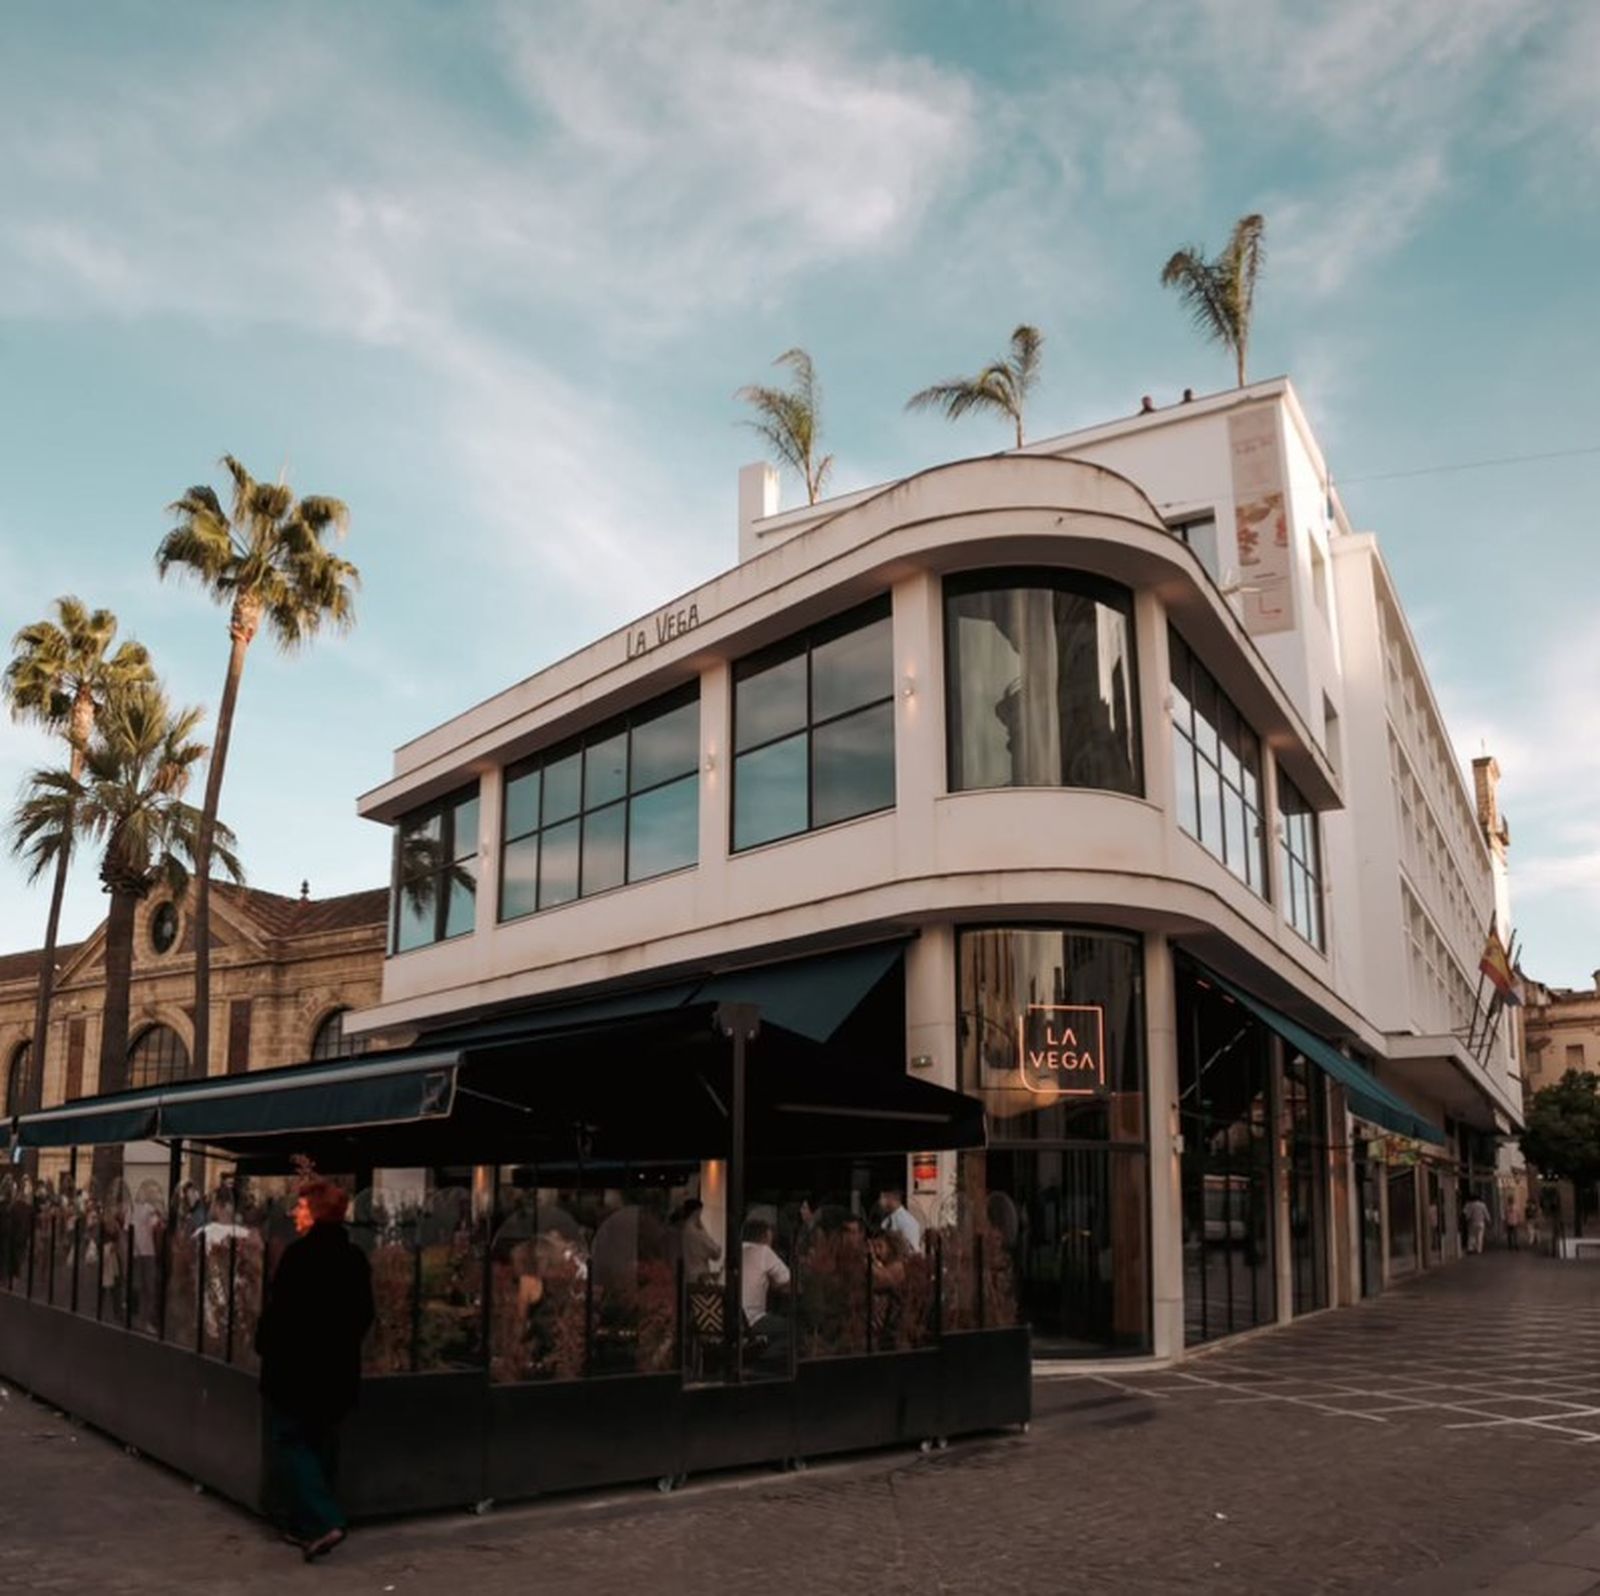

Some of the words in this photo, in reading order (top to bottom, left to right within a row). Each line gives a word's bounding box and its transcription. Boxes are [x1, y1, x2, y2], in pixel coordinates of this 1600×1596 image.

[626, 630, 646, 660] LA
[656, 604, 700, 643] VEGA
[1046, 1027, 1077, 1045] LA
[1029, 1051, 1095, 1070] VEGA
